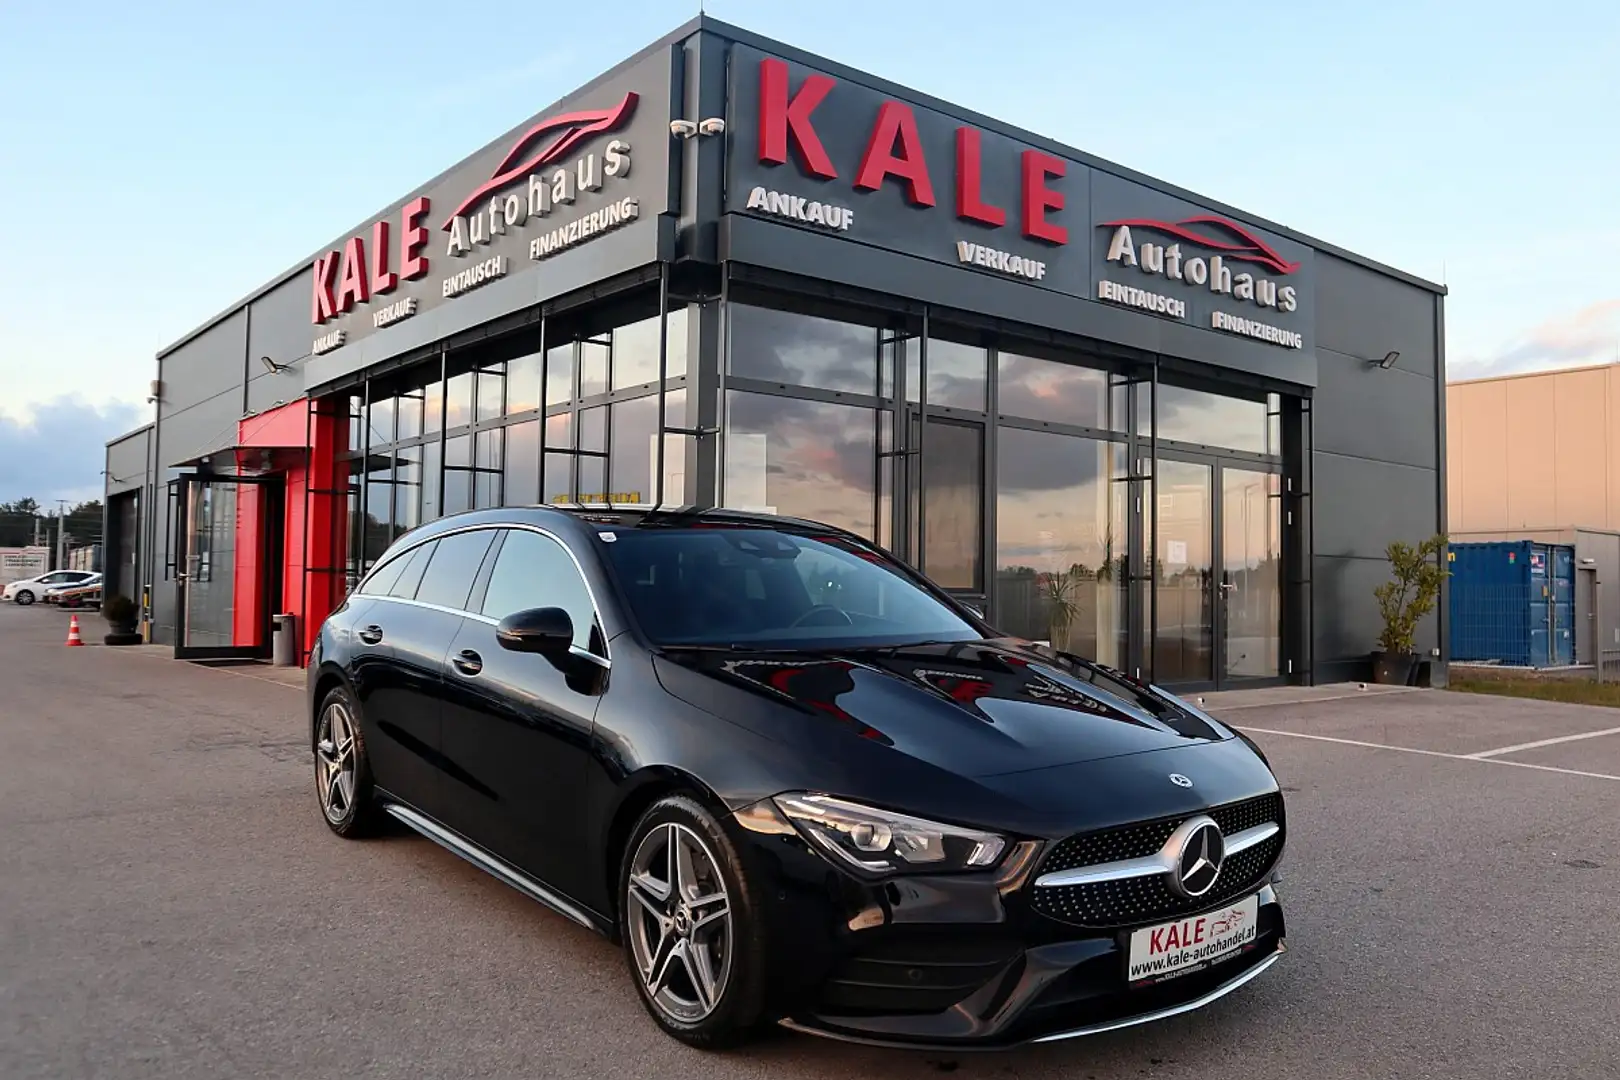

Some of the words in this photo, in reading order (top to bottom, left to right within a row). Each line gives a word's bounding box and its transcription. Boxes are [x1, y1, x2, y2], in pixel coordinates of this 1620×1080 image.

[759, 57, 1068, 246] KALE
[447, 140, 631, 257] Autohaus
[747, 186, 854, 231] ANKAUF
[312, 197, 430, 324] KALE
[312, 329, 346, 355] ANKAUF
[372, 297, 417, 328] VERKAUF
[442, 255, 507, 298] EINTAUSCH
[529, 197, 638, 260] FINANZIERUNG
[957, 240, 1047, 281] VERKAUF
[1107, 225, 1297, 312] Autohaus
[1098, 280, 1186, 318] EINTAUSCH
[1212, 311, 1303, 349] FINANZIERUNG
[1131, 924, 1255, 976] www.kale-autohandel.at
[1149, 917, 1207, 955] KALE
